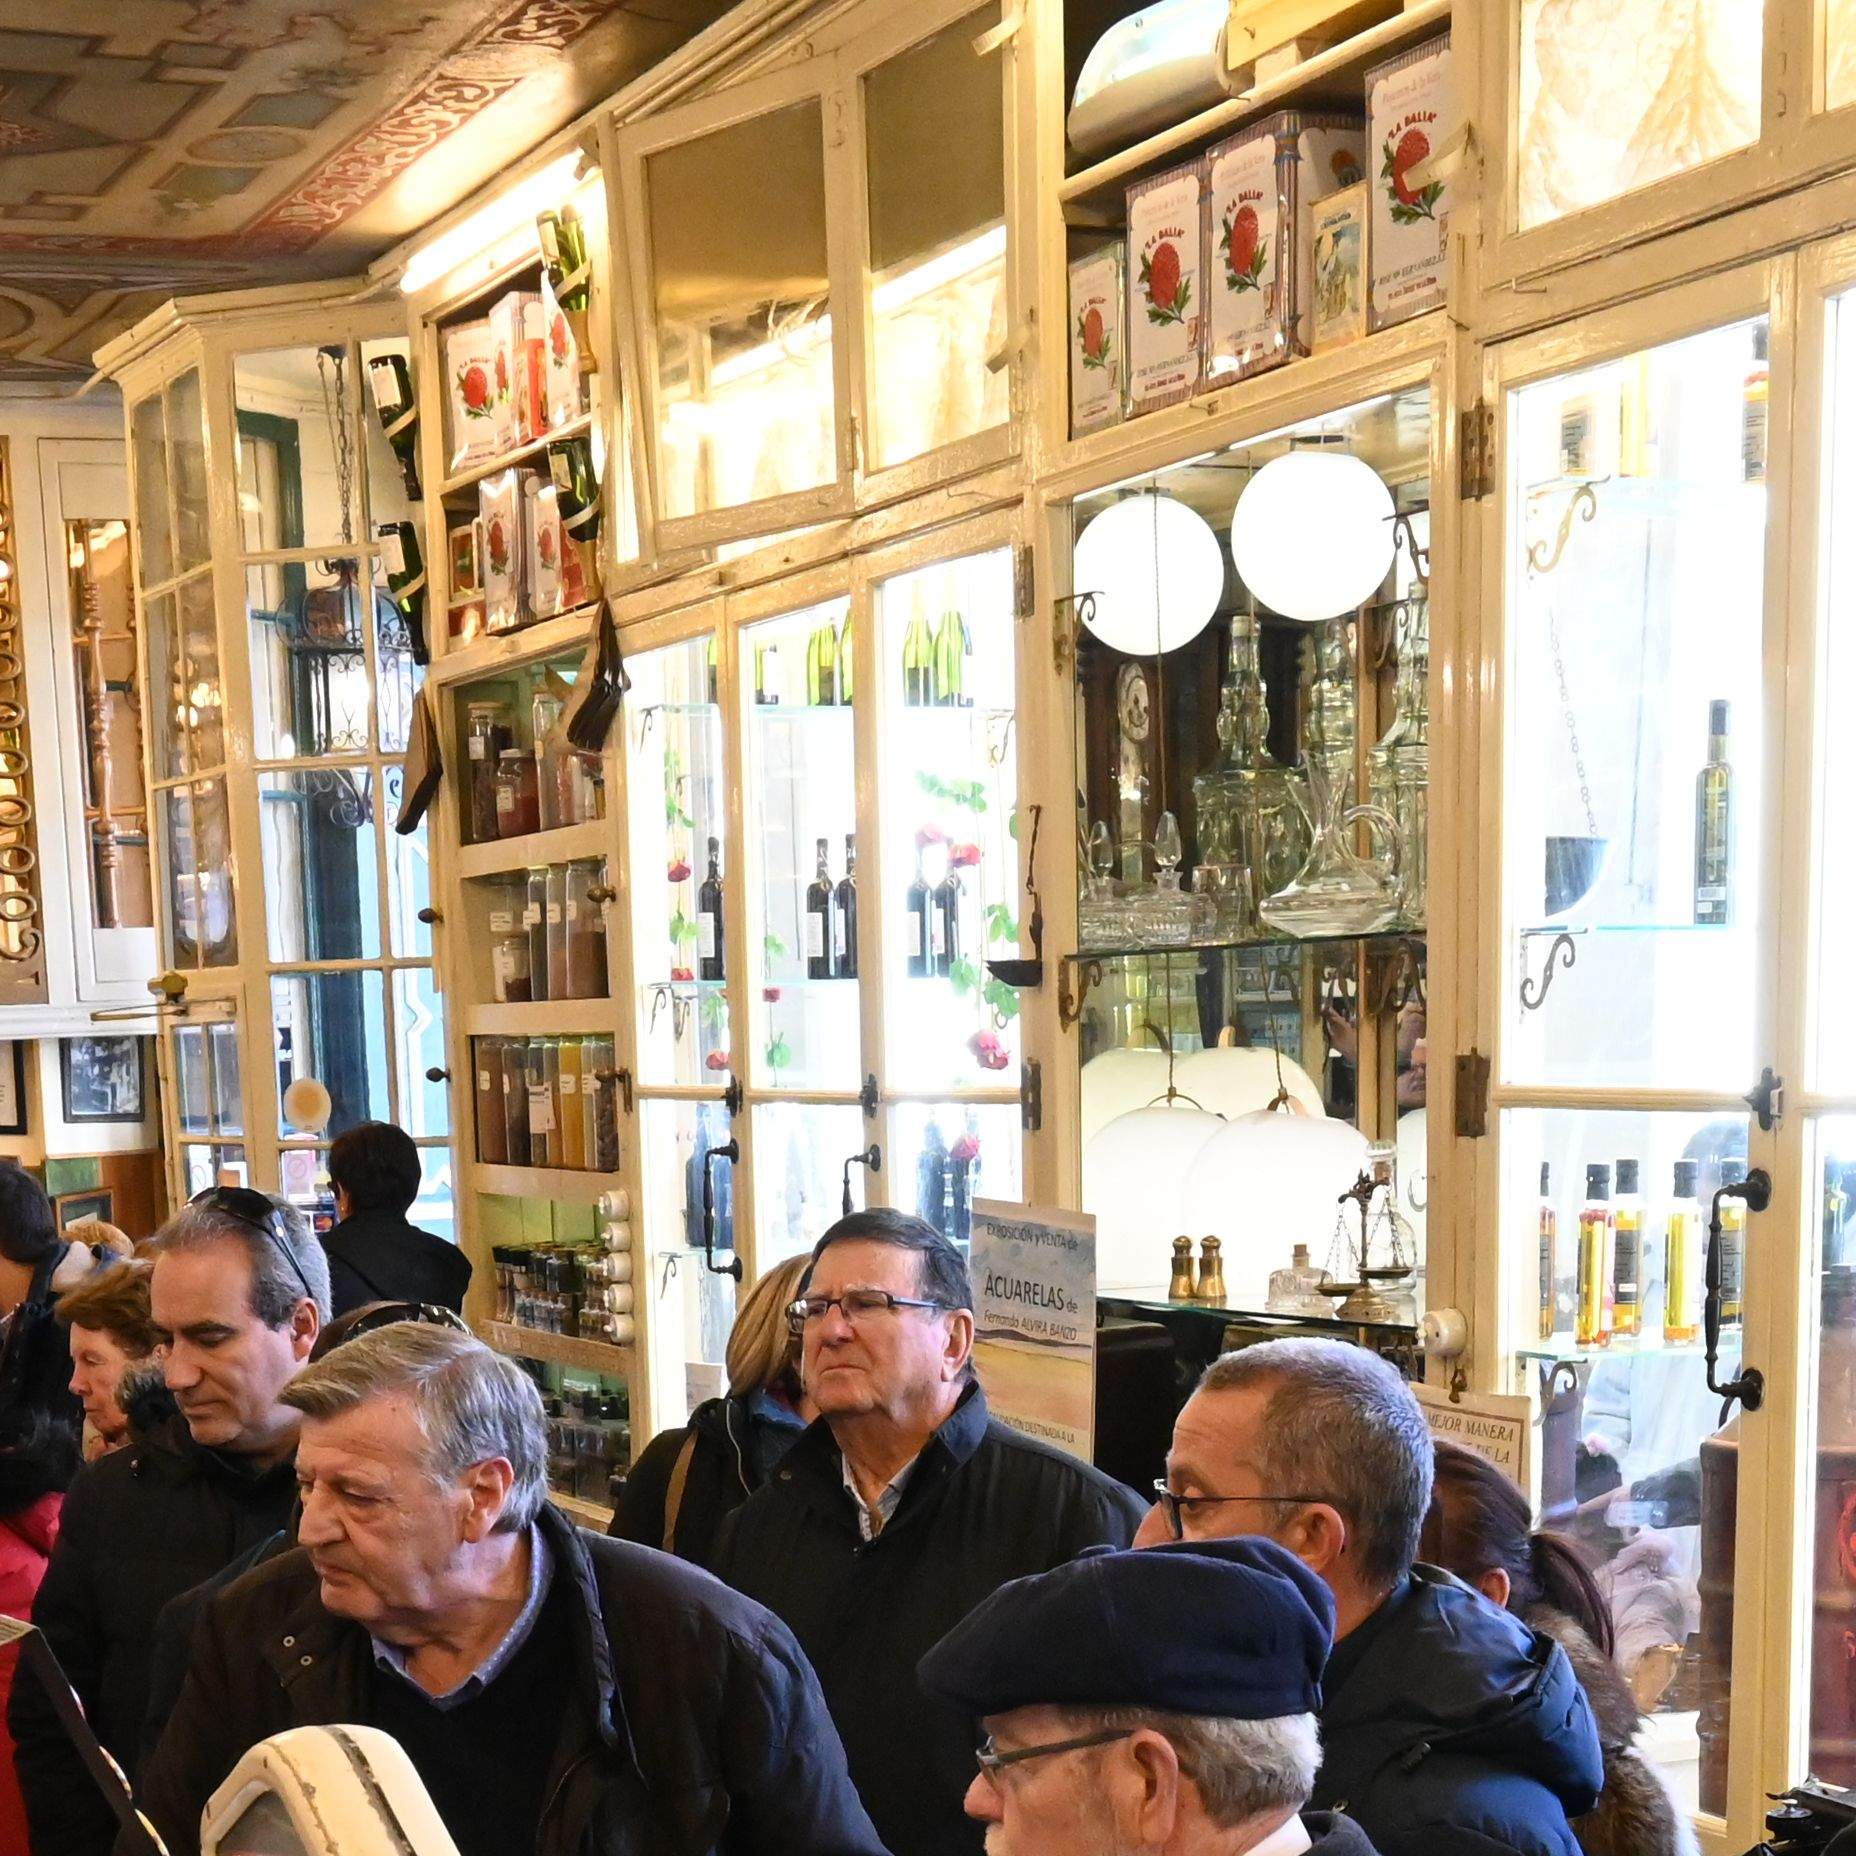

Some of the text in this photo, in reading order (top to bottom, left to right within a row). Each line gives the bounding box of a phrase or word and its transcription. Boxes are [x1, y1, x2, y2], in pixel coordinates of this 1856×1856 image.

[984, 1272, 1078, 1314] ACUARELAS de
[984, 1308, 1020, 1329] Fernando
[1021, 1315, 1047, 1335] ALVIRA
[1465, 1420, 1514, 1443] MANERA
[1494, 1447, 1510, 1464] LA
